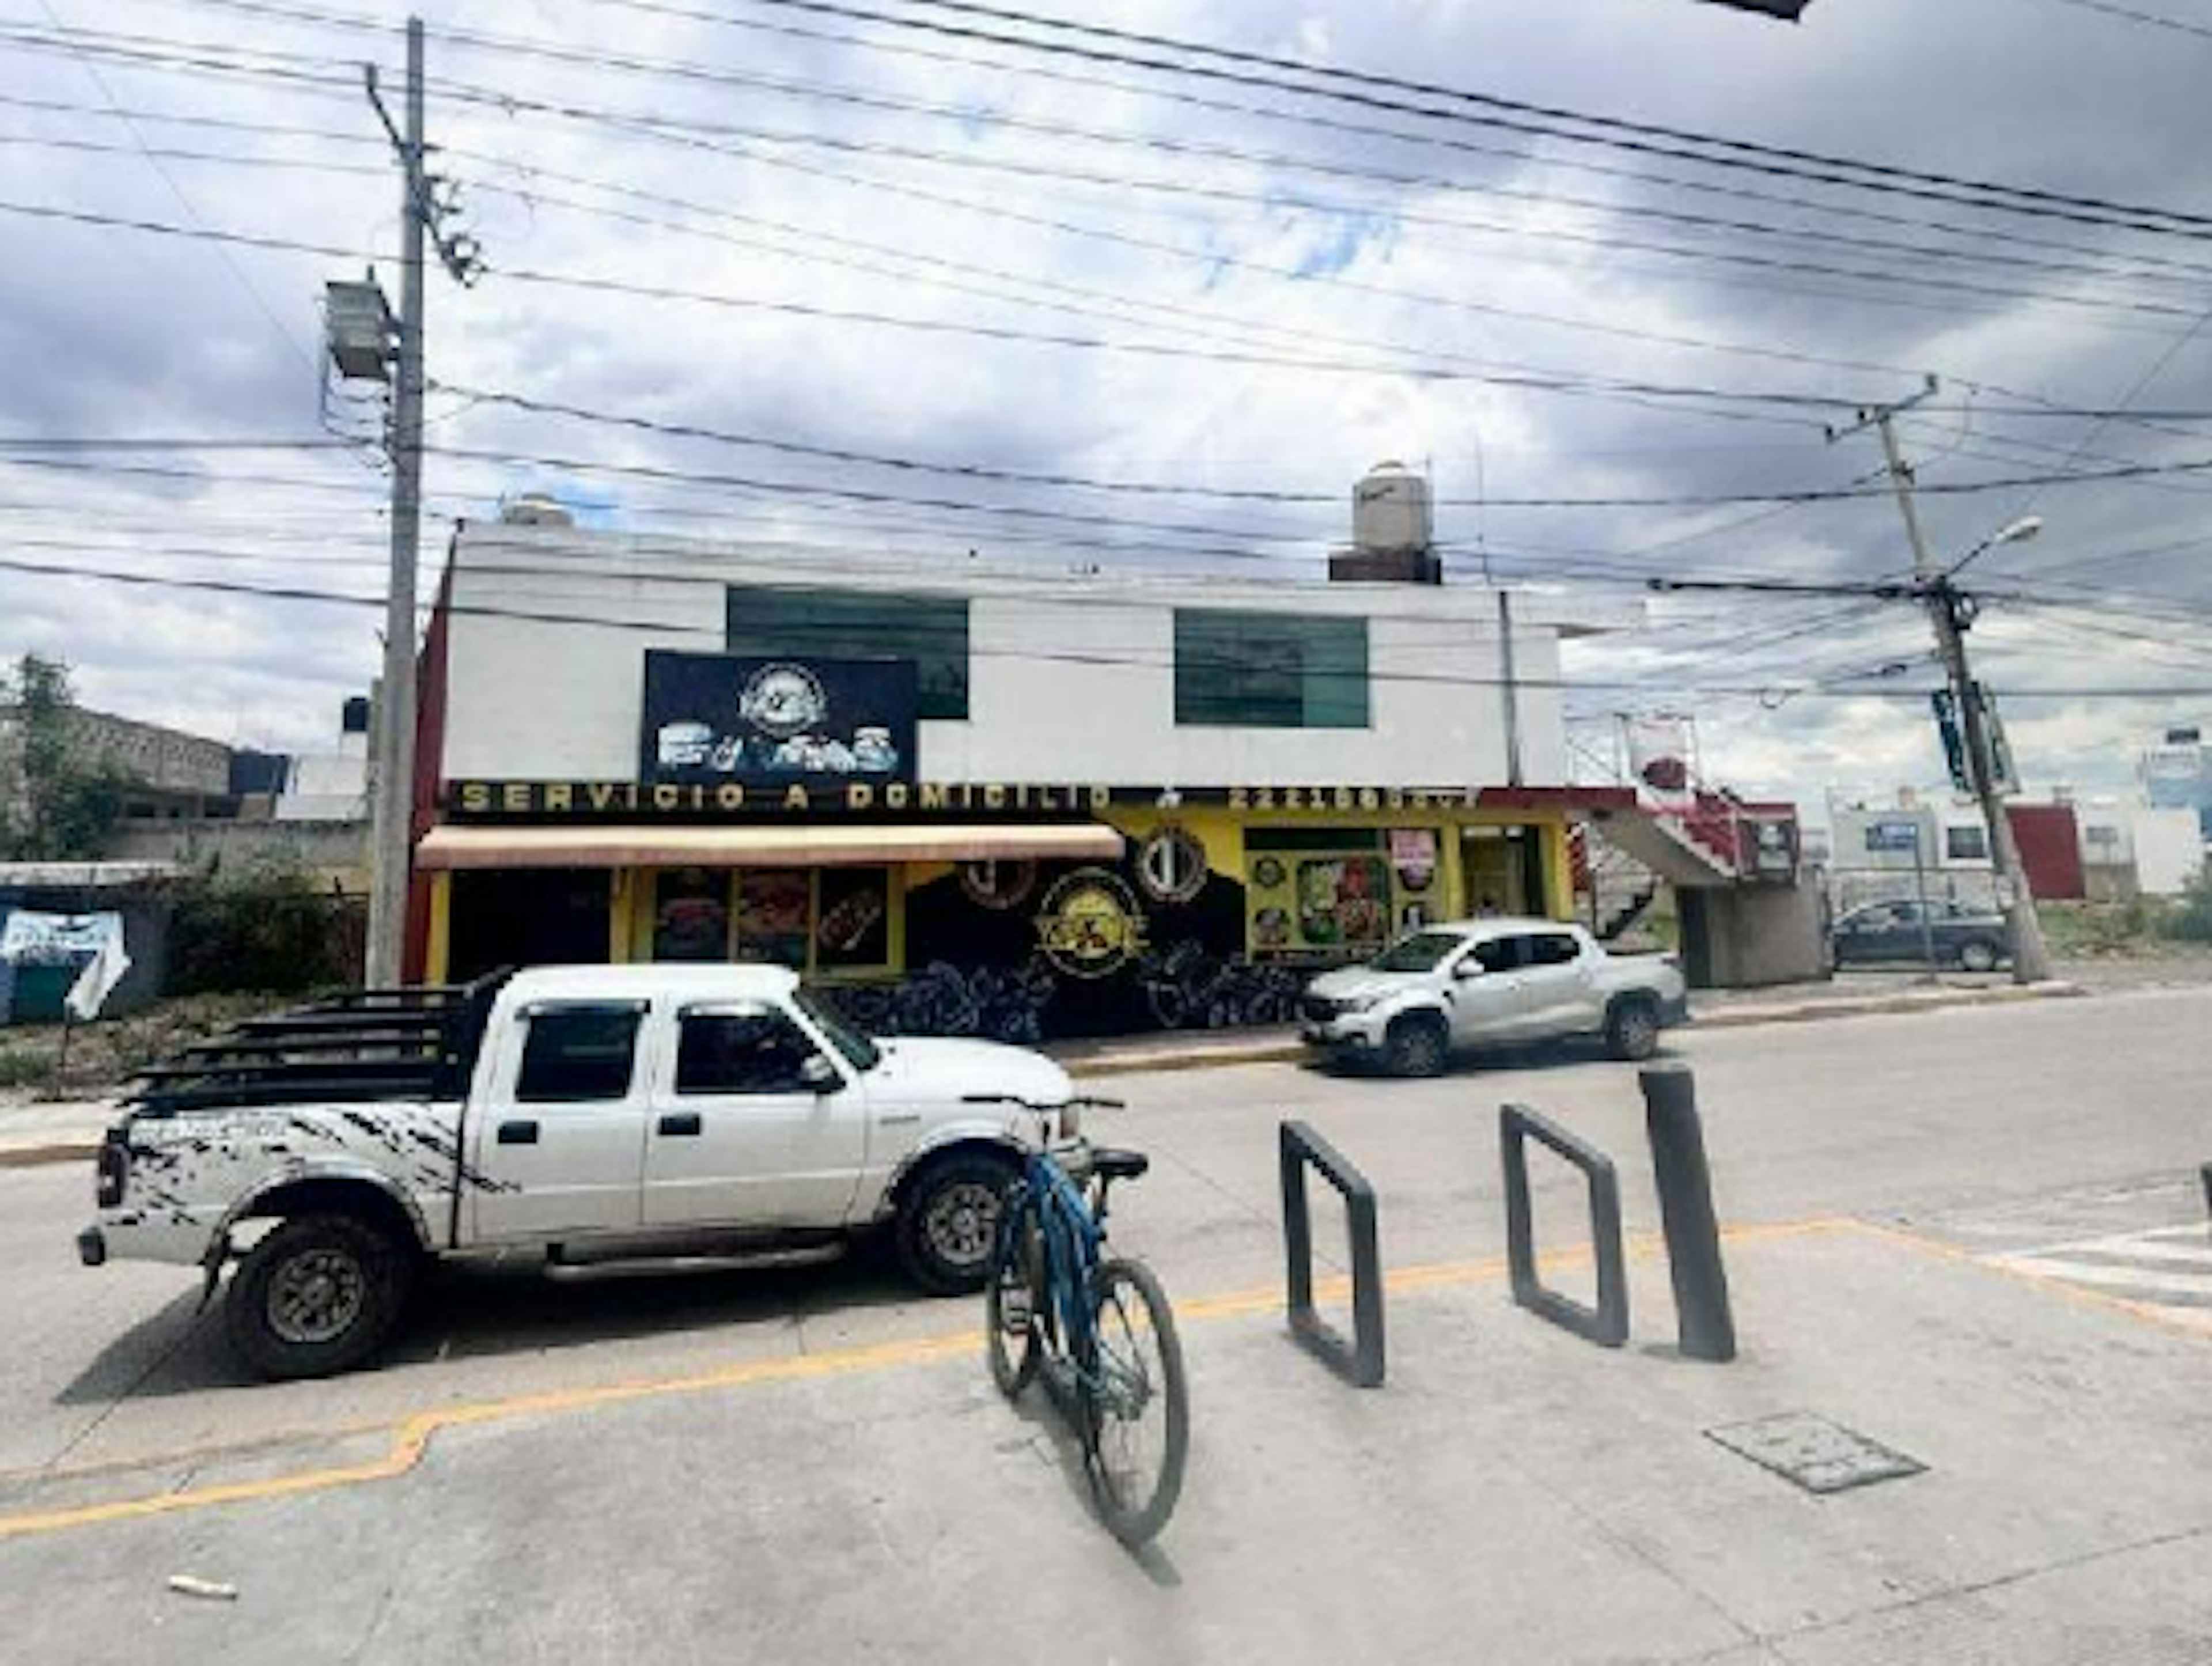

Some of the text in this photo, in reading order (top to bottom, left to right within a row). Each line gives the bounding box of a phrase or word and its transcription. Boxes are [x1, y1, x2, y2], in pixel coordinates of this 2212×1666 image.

[462, 783, 745, 812] SERVICIO
[786, 783, 809, 810] A
[847, 782, 1111, 809] DOMICILIO
